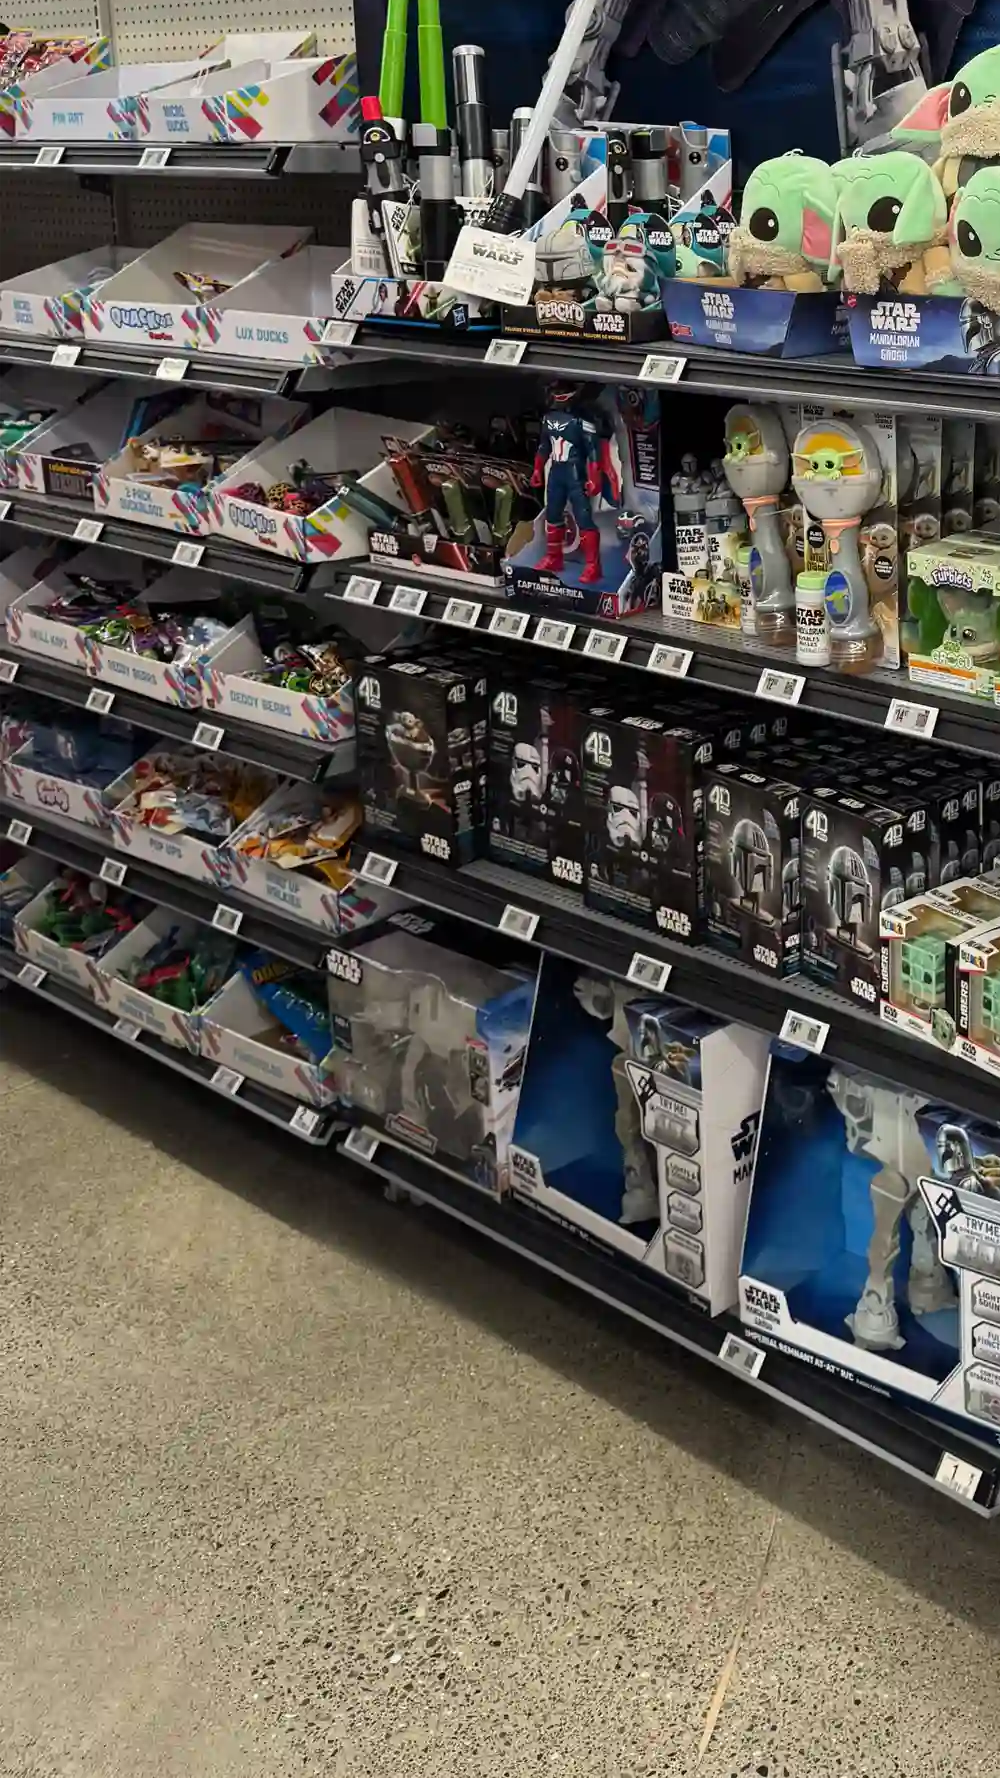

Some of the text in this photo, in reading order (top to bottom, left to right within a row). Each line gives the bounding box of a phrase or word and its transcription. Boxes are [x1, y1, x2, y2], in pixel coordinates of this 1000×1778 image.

[537, 301, 584, 322] PERCH'D
[870, 302, 920, 317] STAR
[594, 314, 625, 325] STAR
[594, 321, 624, 332] WARS
[871, 316, 920, 332] WARS
[235, 326, 289, 344] LUX DUCKS
[870, 334, 920, 347] MANDALORIAN
[932, 567, 973, 590] Furblets
[517, 580, 584, 599] CAPTAIN AMERICA
[880, 946, 889, 993] CUBERS
[960, 980, 968, 1029] CUBERS
[965, 1217, 984, 1231] TRY
